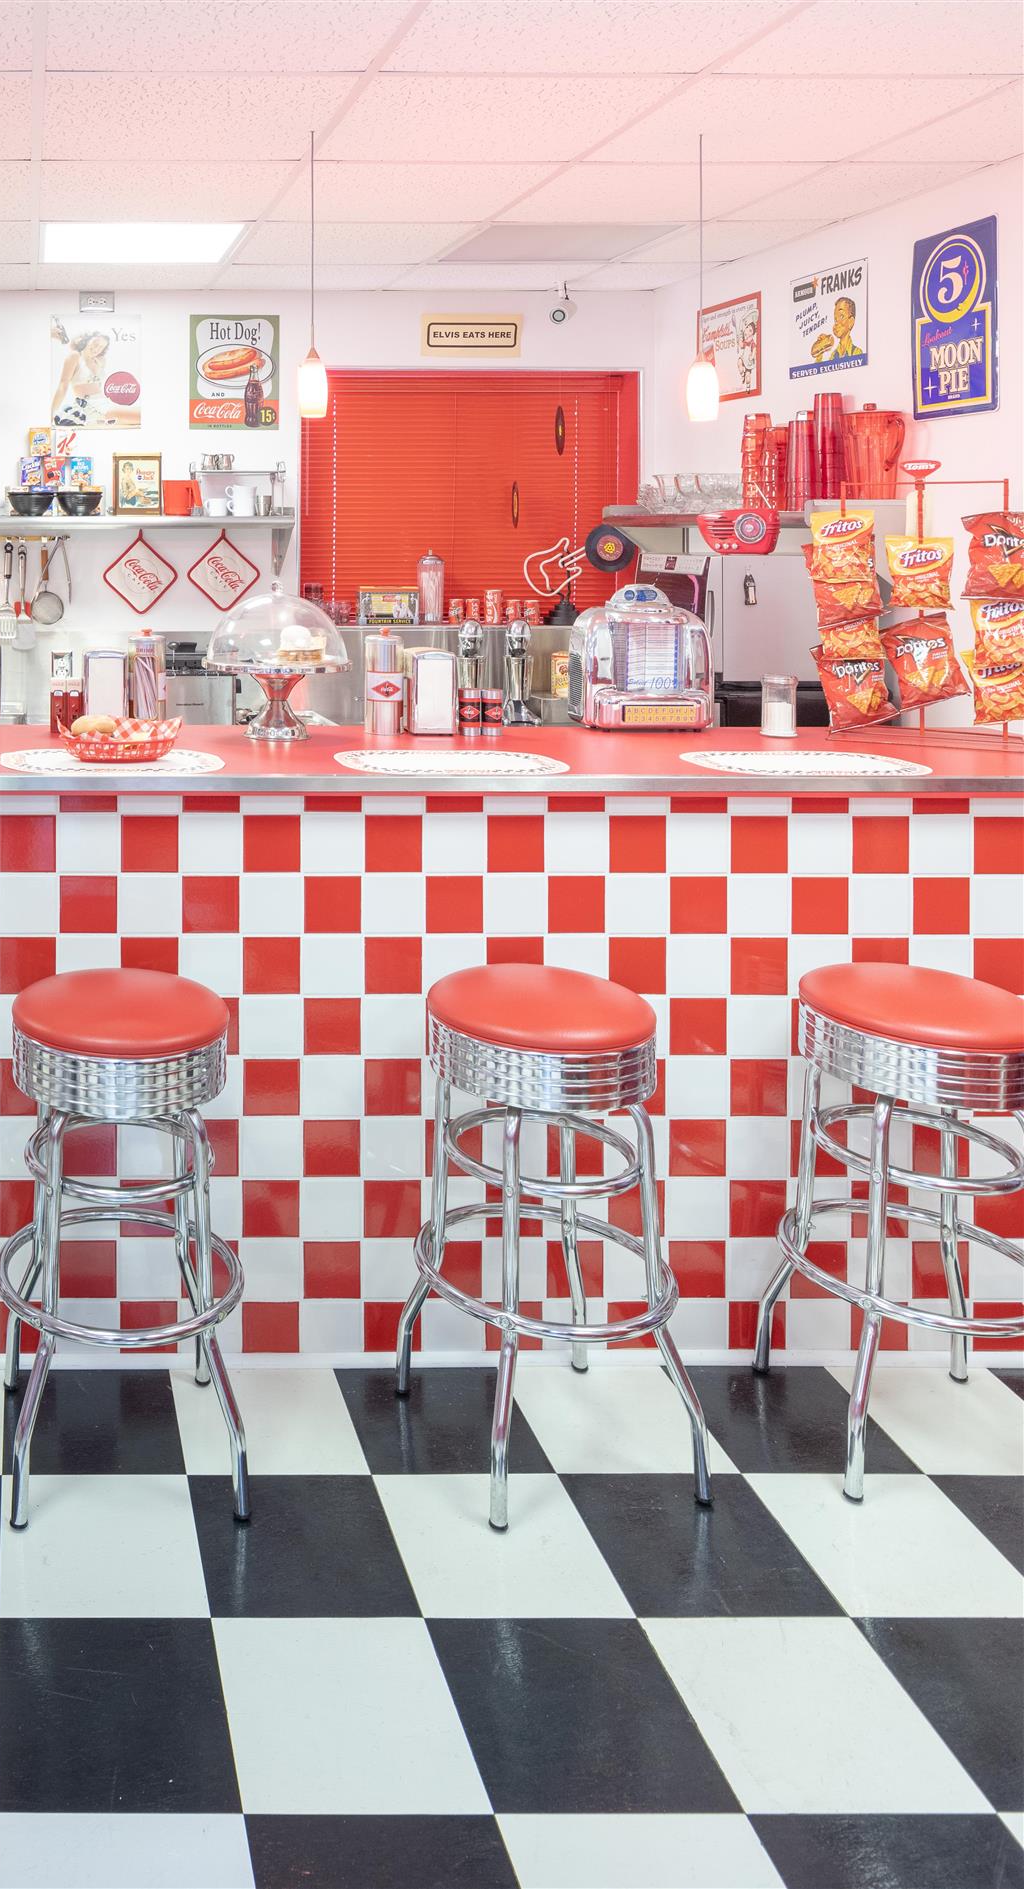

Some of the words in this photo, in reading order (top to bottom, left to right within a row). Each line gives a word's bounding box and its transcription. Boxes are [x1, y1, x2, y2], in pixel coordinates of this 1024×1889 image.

[820, 266, 862, 296] FRANKS
[796, 302, 818, 322] PLUMP,
[799, 311, 820, 329] JUICY,
[112, 328, 136, 342] Yes
[210, 322, 230, 340] Hot
[235, 322, 261, 345] Dog!
[802, 316, 828, 338] TENDER!
[922, 326, 952, 347] Lookout
[930, 336, 984, 372] MOON
[792, 368, 817, 379] SERVED
[820, 358, 863, 374] EXCLUSIVELY
[106, 383, 136, 394] Coca-Cola
[938, 367, 970, 396] PIE
[193, 402, 242, 419] Coca-Cola
[821, 520, 863, 537] Fritos
[900, 549, 943, 568] Fritos
[124, 559, 163, 591] Coca-Cola
[207, 557, 244, 590] Coca-Cola
[836, 662, 880, 678] Doritos
[651, 677, 671, 689] 100
